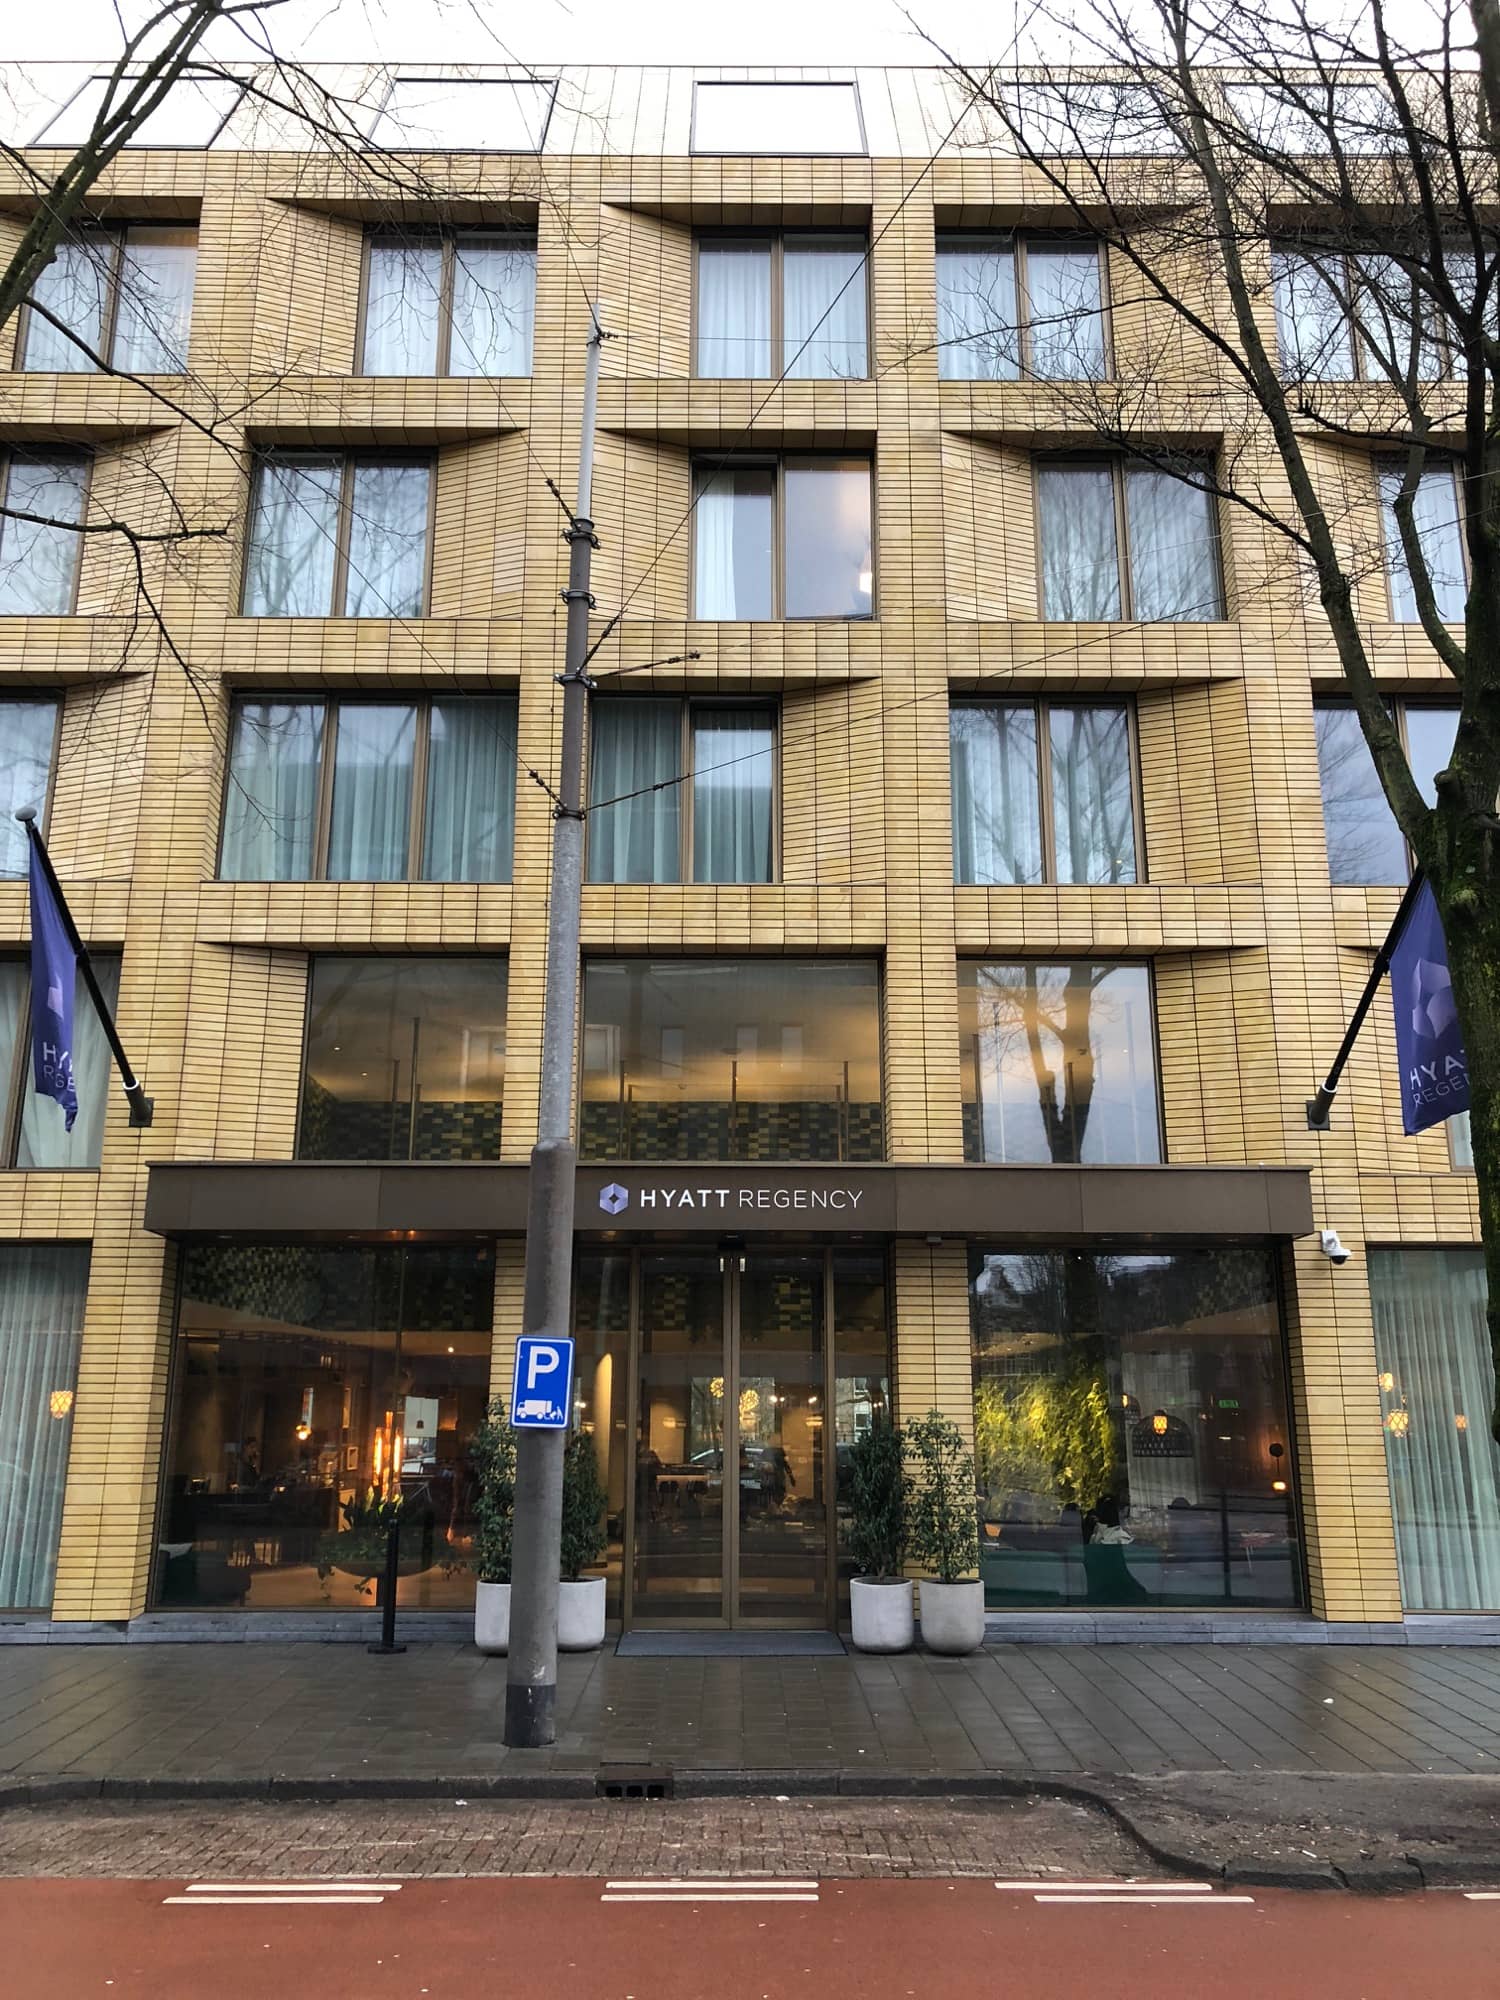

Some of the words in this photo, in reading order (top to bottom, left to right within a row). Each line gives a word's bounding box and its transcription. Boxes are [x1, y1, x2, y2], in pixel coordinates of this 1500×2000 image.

[1410, 1050, 1465, 1090] HYA
[640, 1189, 730, 1208] HYATT
[739, 1189, 863, 1209] REGENCY
[527, 1345, 560, 1390] P
